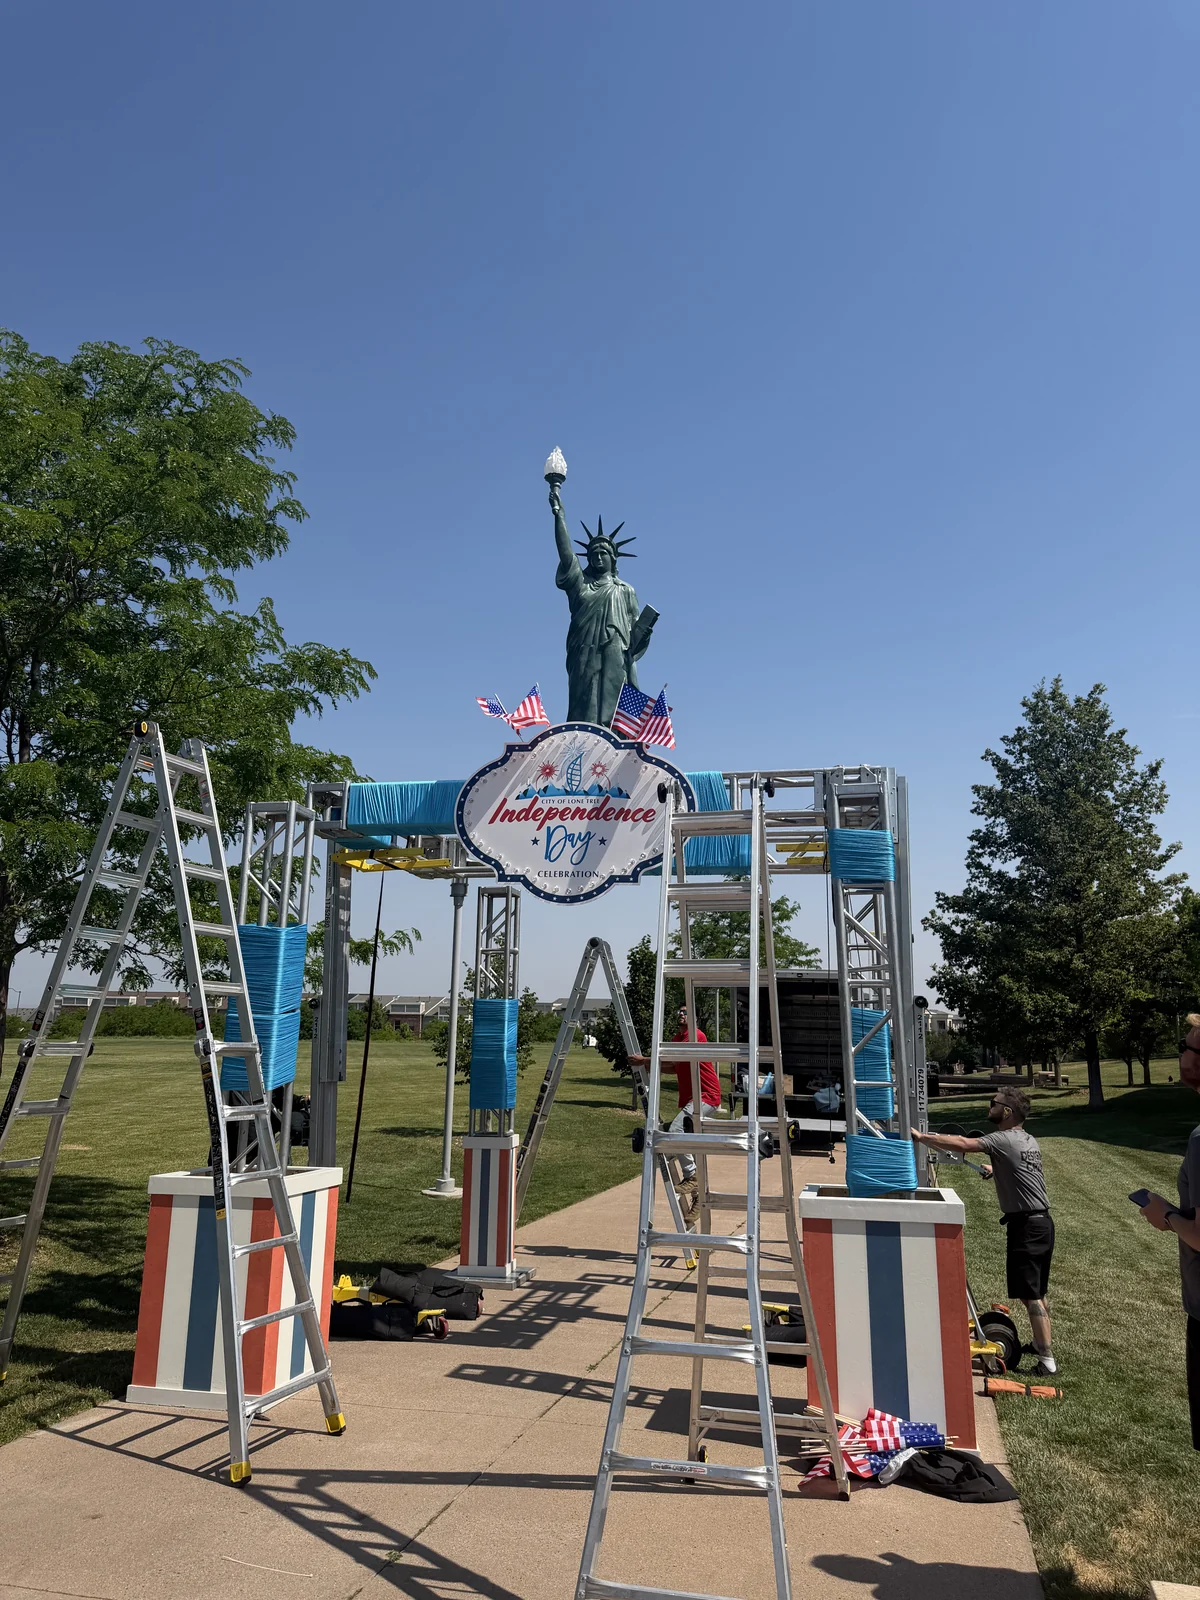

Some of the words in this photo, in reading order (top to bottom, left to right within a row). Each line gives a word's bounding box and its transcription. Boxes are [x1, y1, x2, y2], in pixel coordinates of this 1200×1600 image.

[488, 795, 657, 832] Independence
[544, 825, 597, 866] Day
[537, 870, 600, 879] CELEBRATION
[917, 1068, 925, 1112] 11734079
